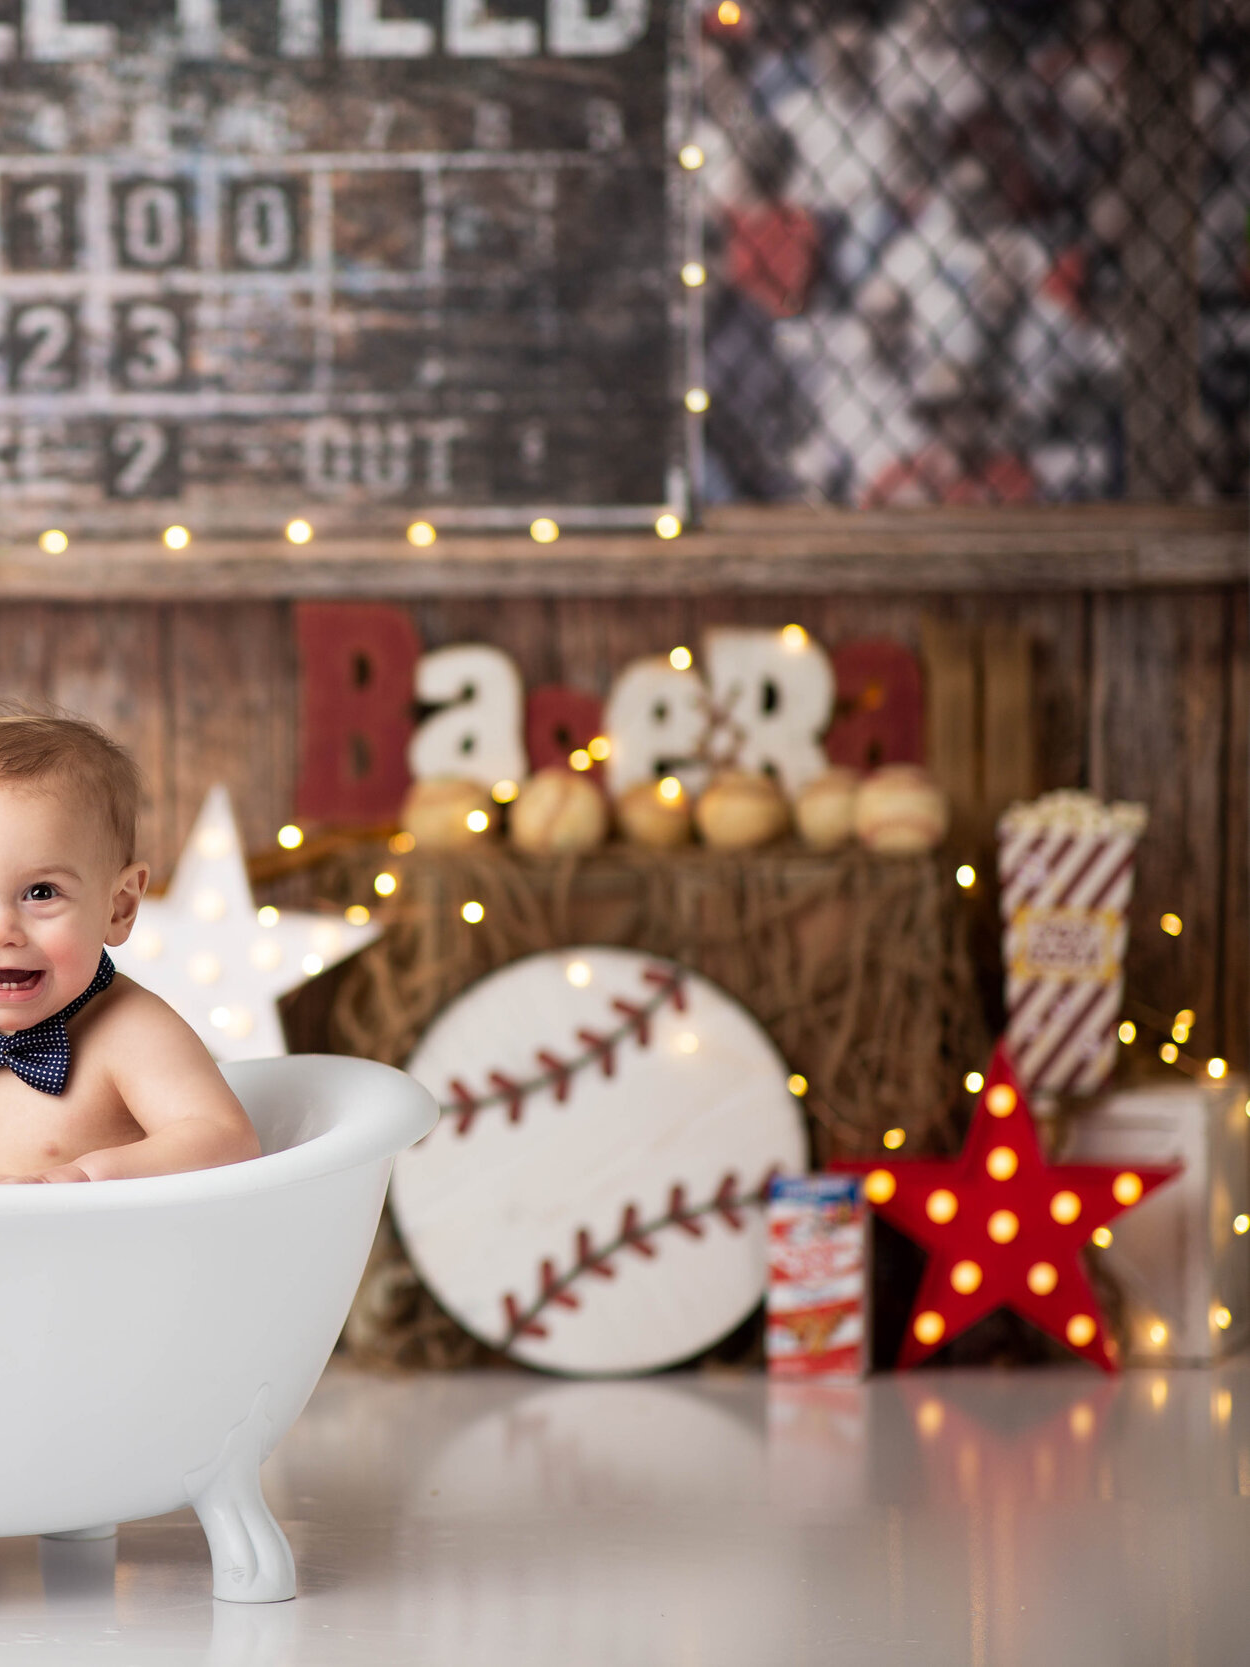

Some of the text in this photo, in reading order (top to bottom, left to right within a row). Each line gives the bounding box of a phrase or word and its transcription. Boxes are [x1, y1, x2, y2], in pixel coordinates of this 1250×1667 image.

[22, 185, 63, 268] 1
[121, 182, 183, 270] 0
[234, 185, 293, 269] 0
[14, 305, 75, 388] 2
[123, 304, 183, 387] 3
